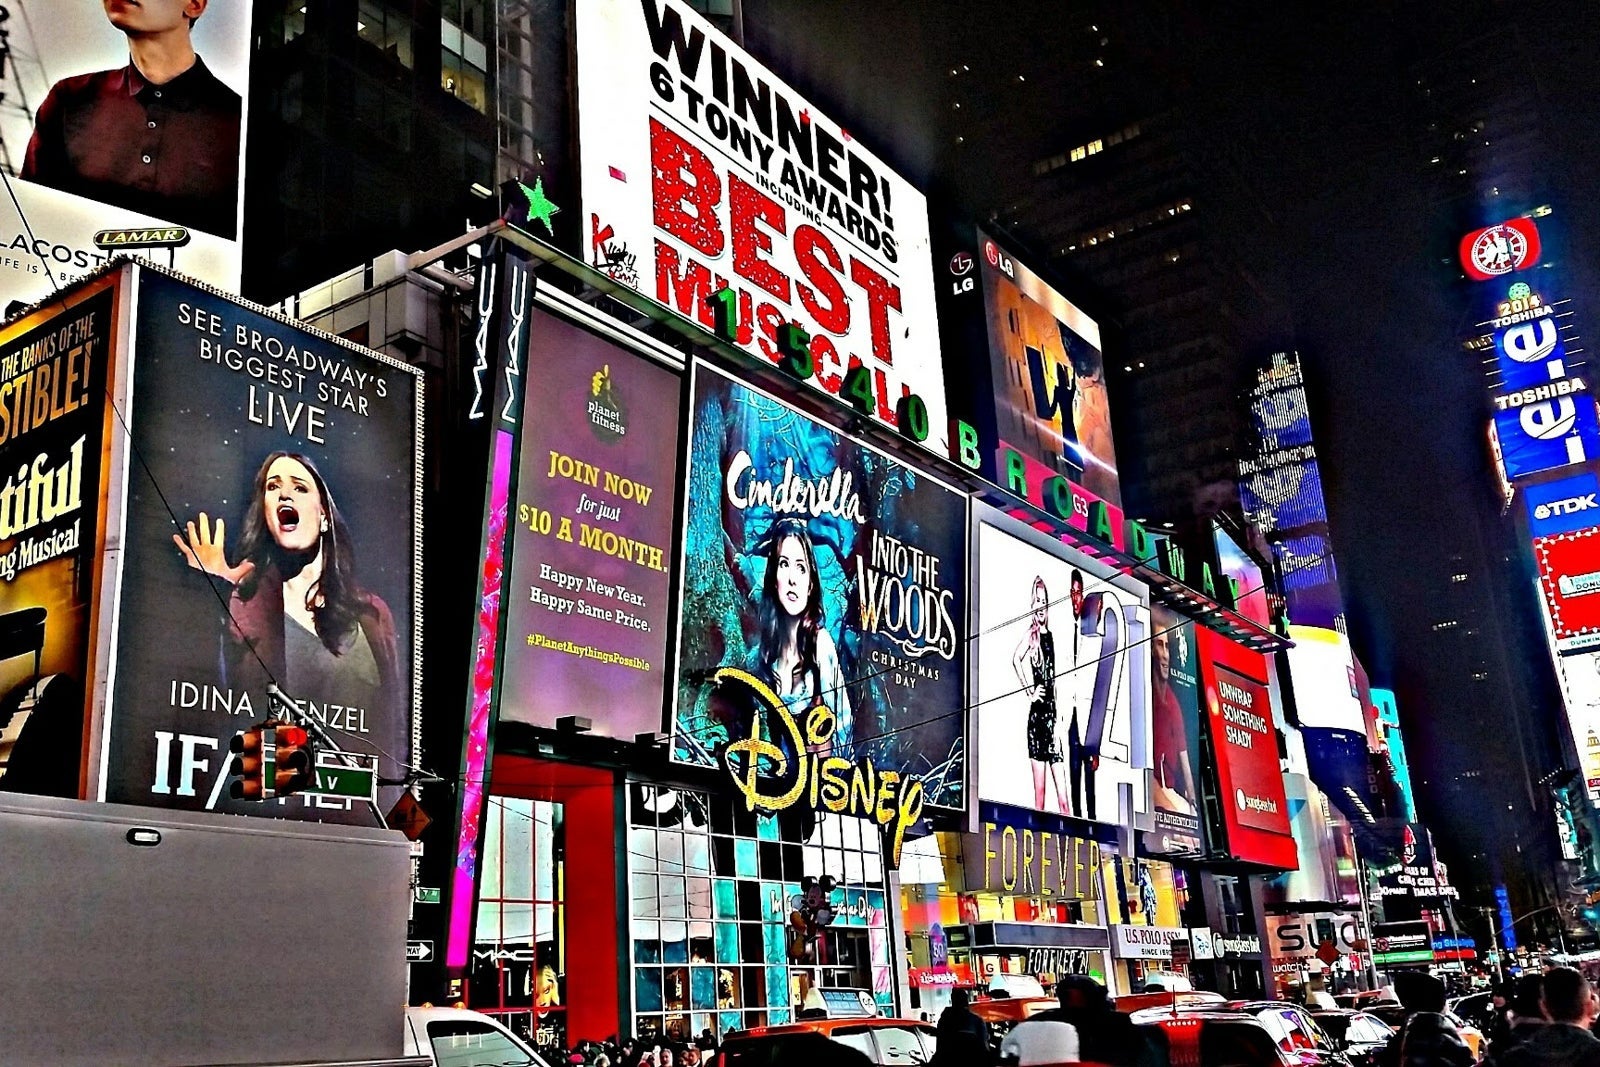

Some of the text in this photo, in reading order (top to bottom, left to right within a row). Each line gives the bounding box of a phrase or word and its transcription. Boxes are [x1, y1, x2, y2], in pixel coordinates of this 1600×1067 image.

[641, 0, 895, 231] WINNER!
[650, 62, 898, 263] 6 TONY AWARDS
[755, 172, 822, 227] INCLUDING
[101, 230, 178, 243] LAMAR
[649, 115, 902, 366] BEST
[27, 264, 38, 274] IS
[998, 252, 1014, 278] LG
[953, 278, 974, 295] LG
[1499, 294, 1542, 315] 2014
[1494, 305, 1554, 328] TOSHIBA
[1, 312, 97, 382] THE RANKS OF THE
[178, 303, 387, 398] SEE BROADWAY'S
[200, 338, 369, 417] BIGGEST STAR
[1495, 378, 1586, 410] TOSHIBA
[248, 384, 326, 444] LIVE
[588, 401, 620, 421] planet
[592, 414, 626, 435] fitness
[706, 287, 1238, 611] 1540 BROADWAY
[548, 451, 653, 506] JOIN NOW
[727, 450, 867, 524] Cinderella
[576, 493, 620, 522] for just
[1073, 493, 1089, 517] G3
[1547, 493, 1599, 515] TDK
[17, 517, 81, 570] Musical
[519, 504, 668, 572] $10 A MONTH.
[872, 529, 940, 592] INTO THE
[540, 563, 646, 607] Happy New Year.
[530, 586, 652, 632] Happy Same Price.
[856, 554, 956, 660] WOODS
[527, 634, 650, 671] #PlanetAnythingsPossible
[871, 650, 940, 681] CHRISTMAS
[170, 680, 255, 718] IDINA
[895, 673, 917, 689] DAY
[1218, 680, 1253, 708] UNWRAP
[1222, 703, 1267, 734] SOMETHING
[1226, 725, 1253, 749] SHADY
[985, 822, 1101, 900] FOREVER
[1125, 928, 1140, 944] U.S.
[1140, 929, 1161, 945] POLO
[1141, 948, 1158, 956] SINCE
